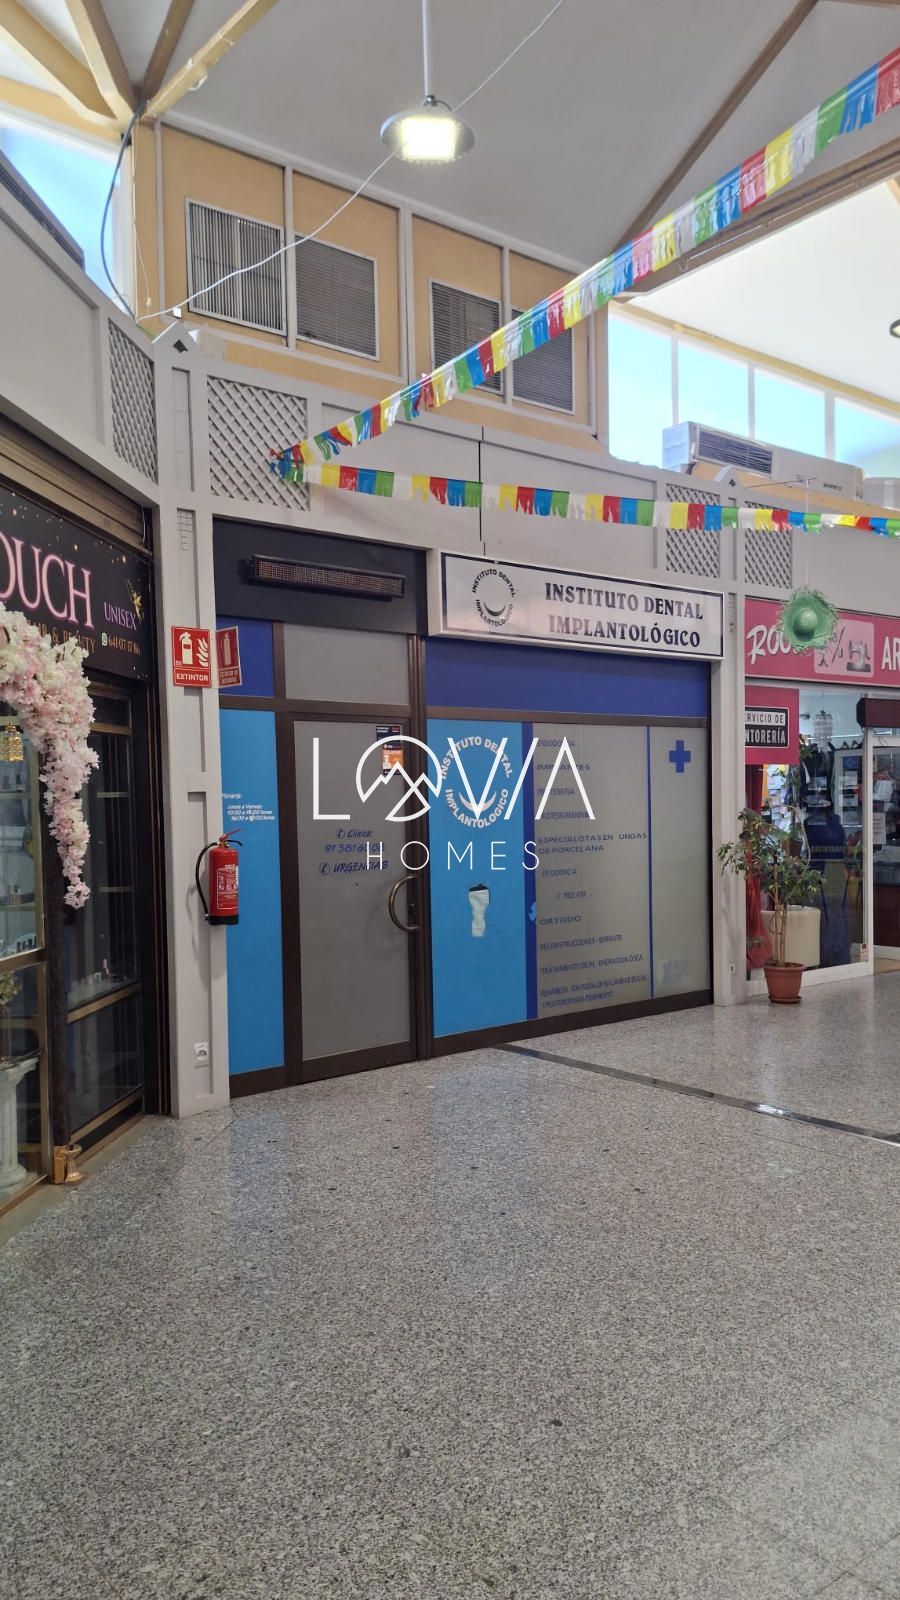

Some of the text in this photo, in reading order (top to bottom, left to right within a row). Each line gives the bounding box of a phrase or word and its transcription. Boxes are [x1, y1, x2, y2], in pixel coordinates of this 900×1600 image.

[472, 569, 516, 598] INSTITUTO DENTAL
[103, 601, 137, 631] UNISEX
[545, 582, 703, 620] INSTITUTO DENTAL
[549, 615, 701, 648] IMPLANTOLÓGICO
[176, 673, 209, 682] EXTINTOR
[744, 712, 784, 724] RVICIO DE
[440, 736, 482, 780] INSTTUTO
[484, 739, 513, 778] DETAL
[445, 789, 509, 829] IMPLANTOLOGICO
